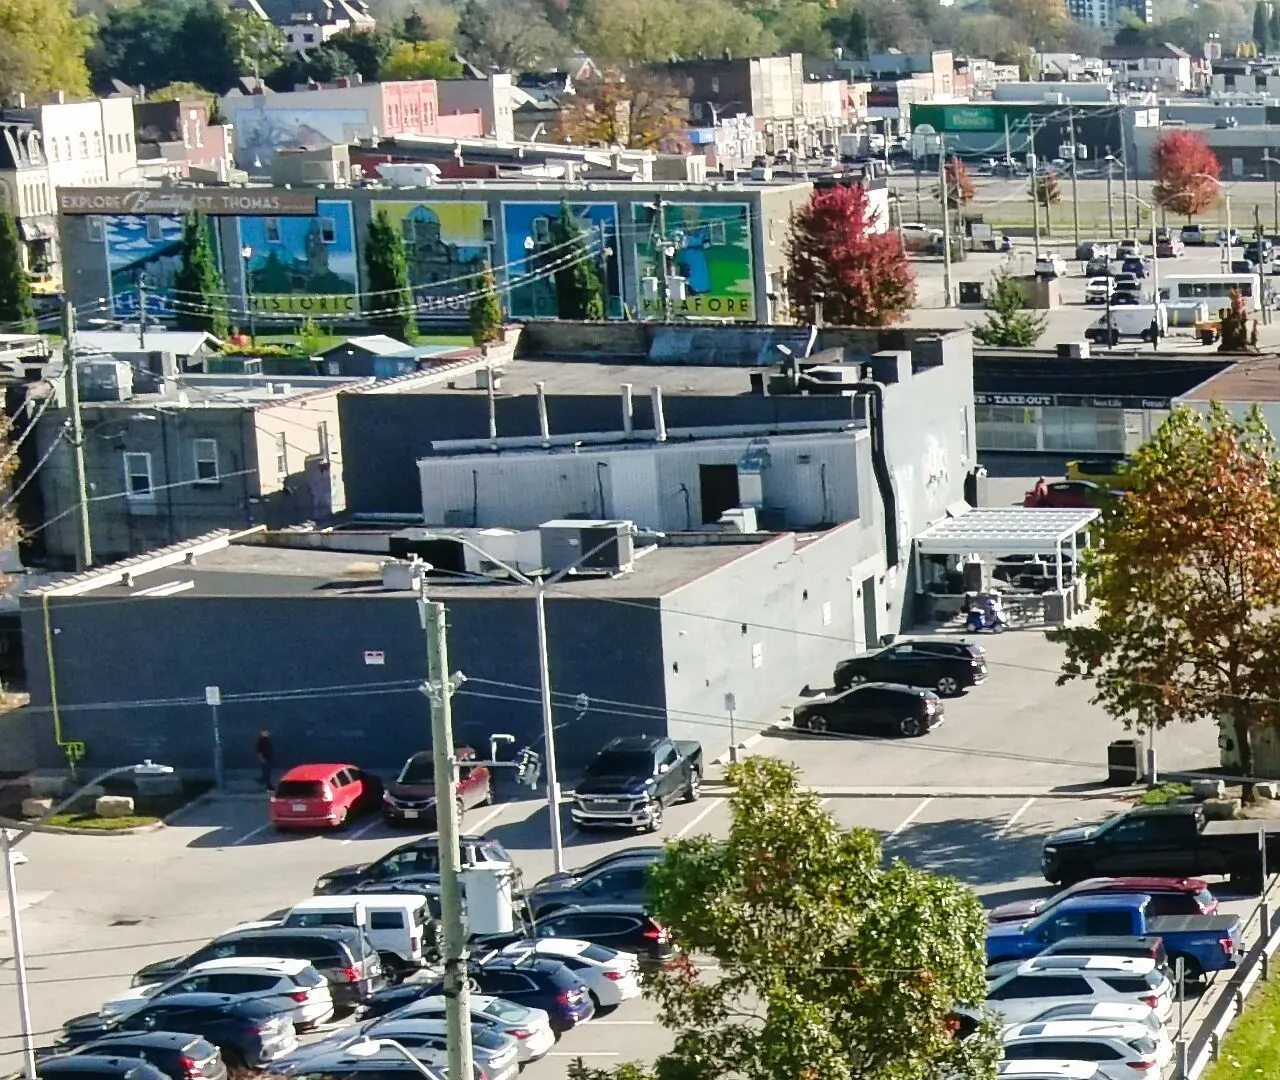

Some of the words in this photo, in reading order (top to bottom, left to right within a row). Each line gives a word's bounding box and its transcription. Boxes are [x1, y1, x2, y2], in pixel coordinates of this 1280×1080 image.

[61, 195, 121, 209] EXPLORE
[221, 196, 279, 210] THOMAS
[247, 296, 354, 310] HISTORIC
